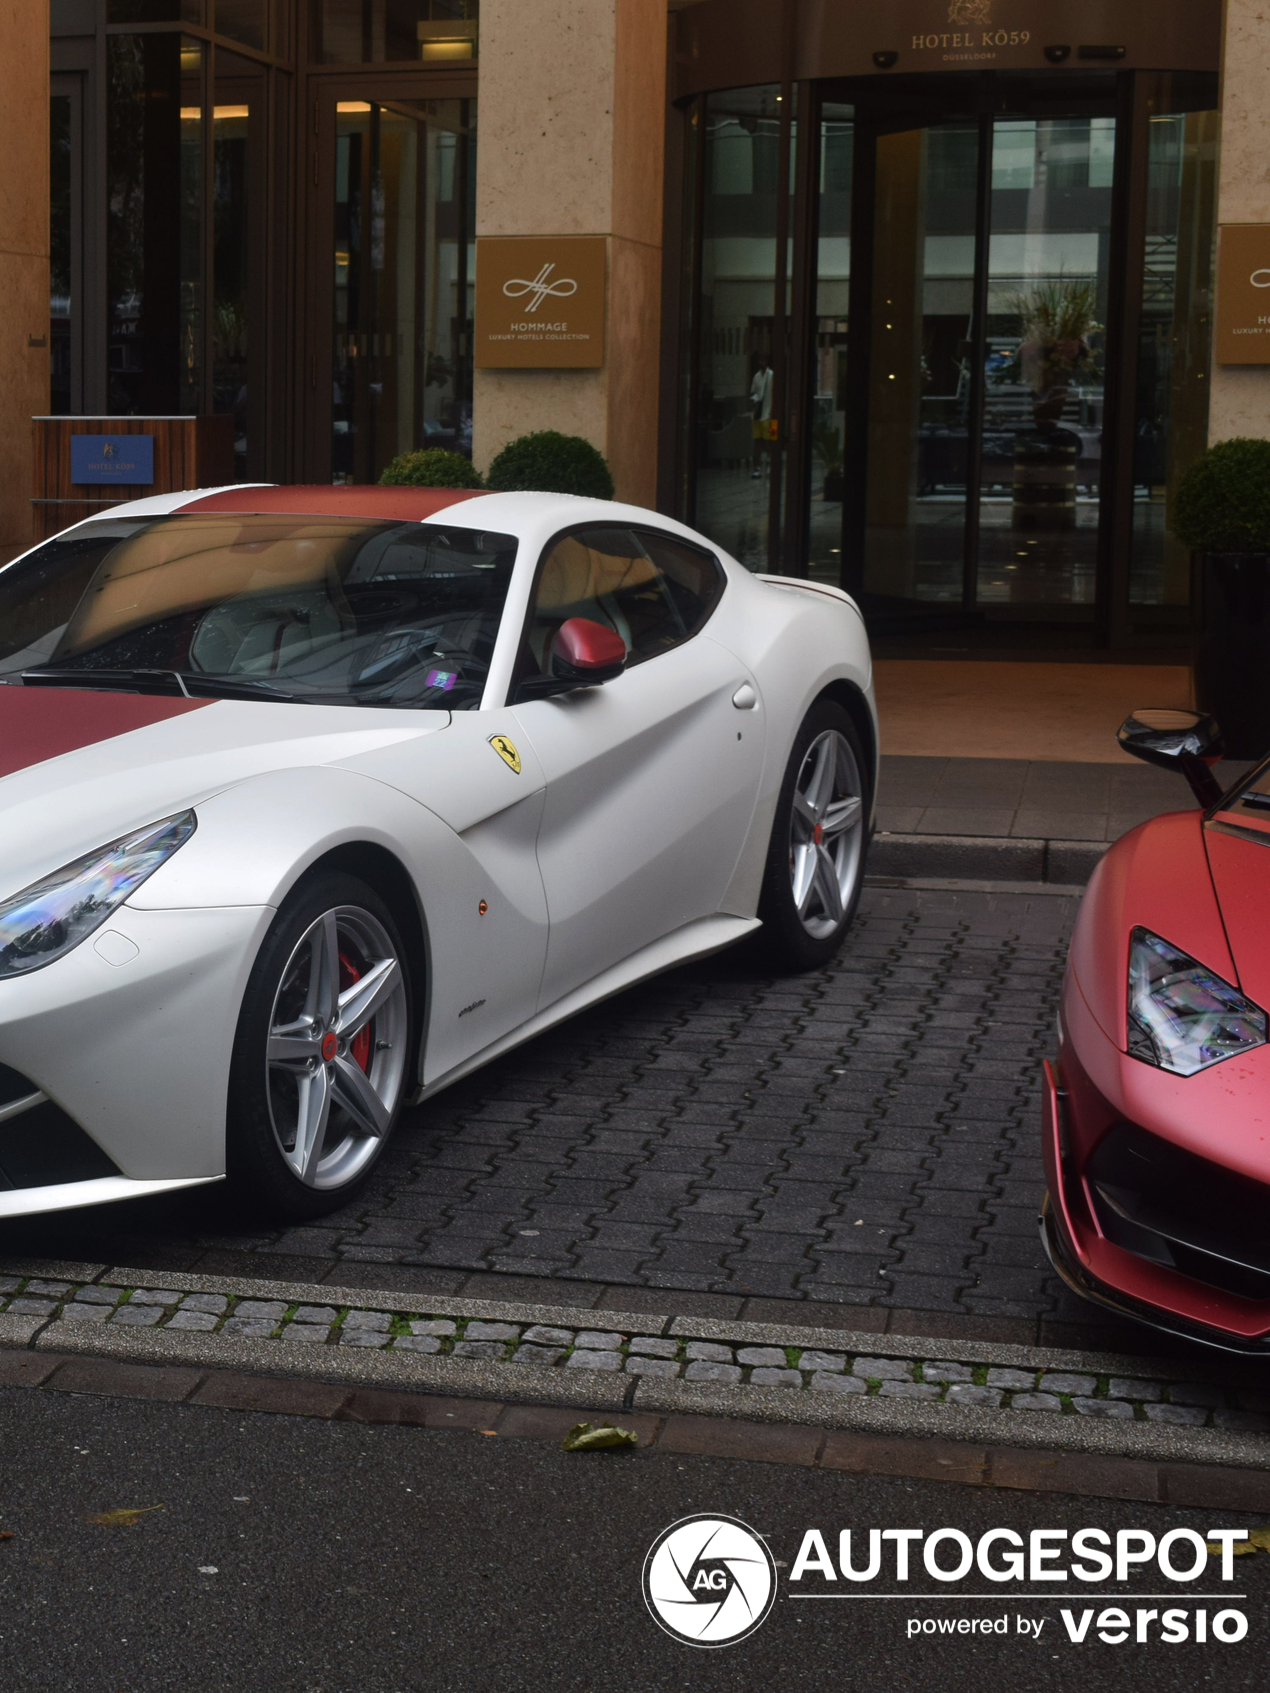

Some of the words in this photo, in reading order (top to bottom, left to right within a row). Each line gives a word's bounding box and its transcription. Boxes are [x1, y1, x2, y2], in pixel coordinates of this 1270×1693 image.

[911, 33, 974, 49] HOTEL
[982, 29, 1030, 46] KÖ59
[510, 322, 568, 332] HOMMAGE
